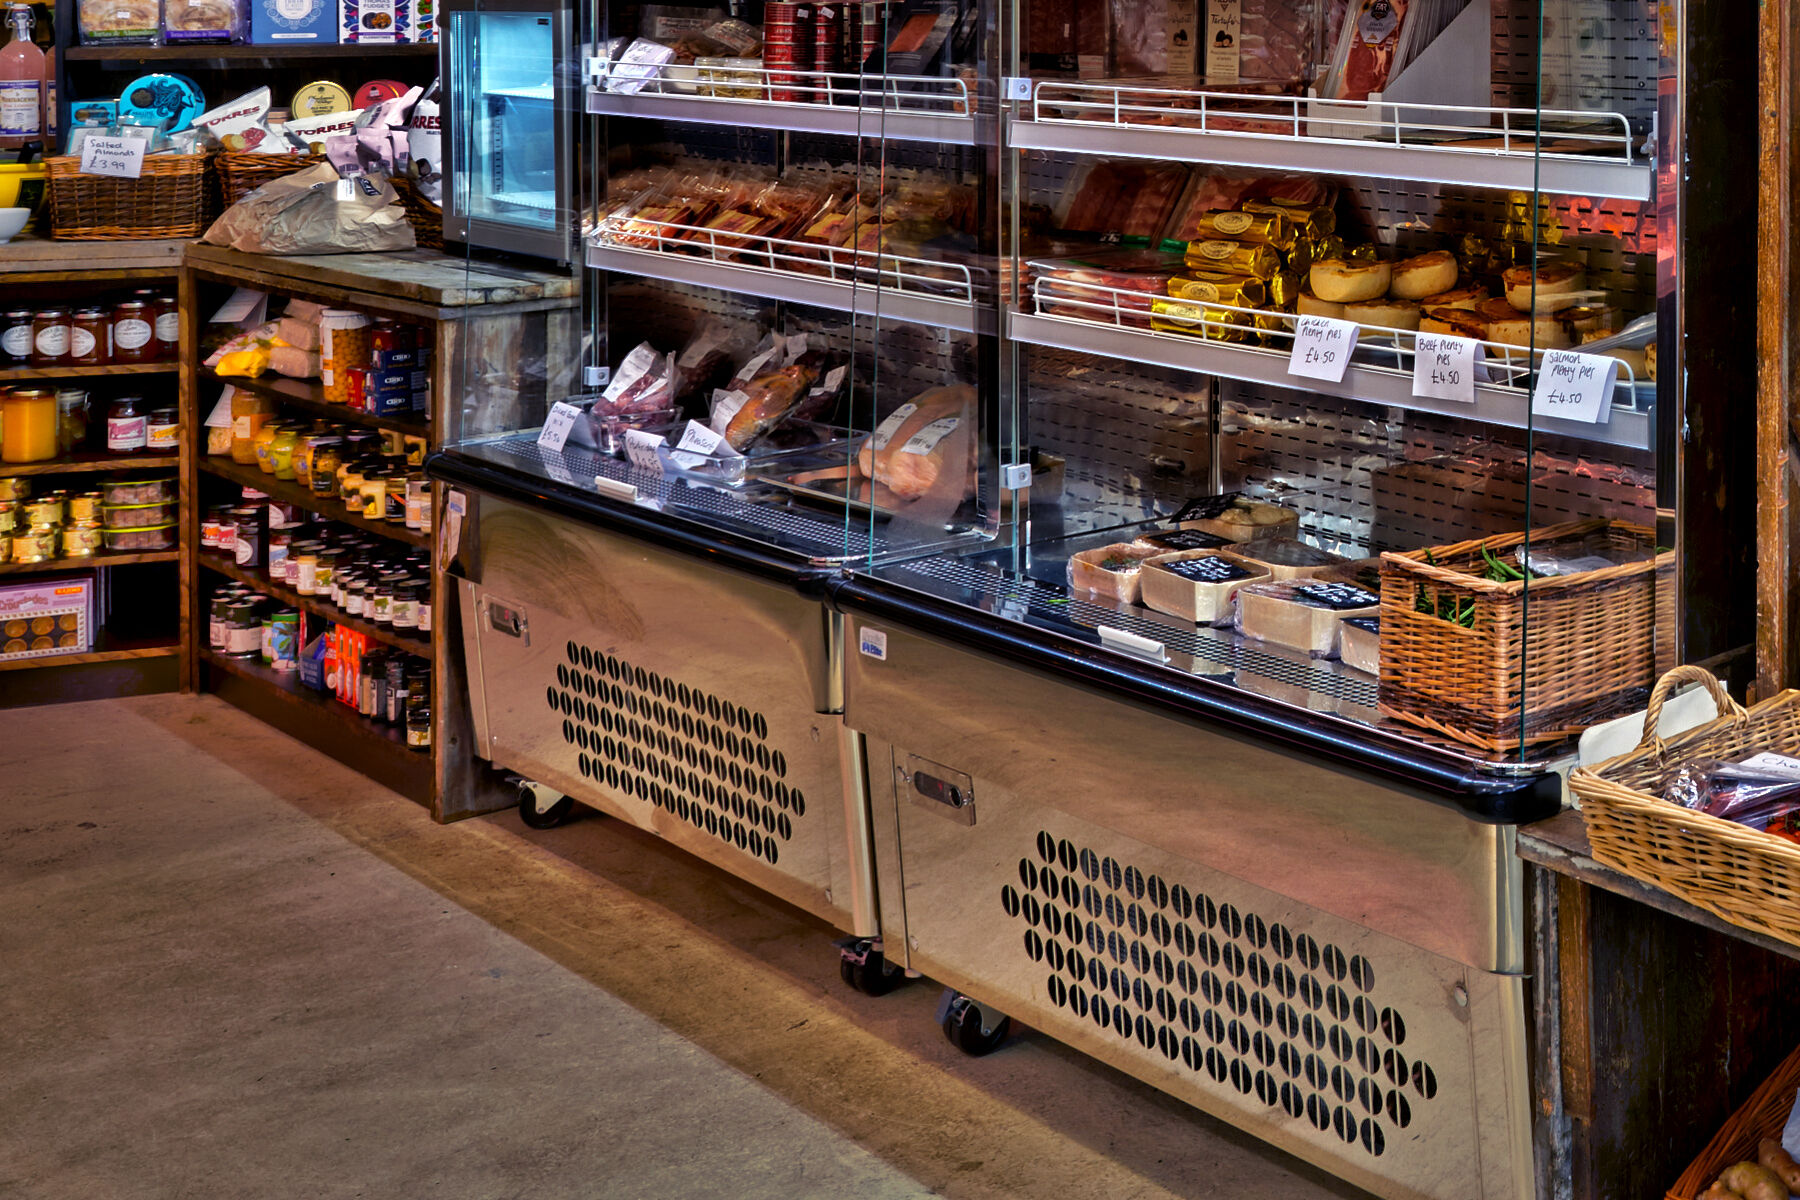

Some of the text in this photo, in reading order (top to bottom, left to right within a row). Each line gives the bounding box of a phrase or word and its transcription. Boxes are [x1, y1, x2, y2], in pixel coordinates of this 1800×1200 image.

[202, 106, 260, 128] TORRES
[295, 121, 355, 136] TORRES
[90, 140, 122, 148] Salted
[95, 148, 134, 157] Almonds
[90, 158, 125, 170] £3.99
[1419, 339, 1437, 351] Beef
[1305, 350, 1335, 364] £4.50
[1431, 371, 1459, 385] £4.50
[1548, 389, 1582, 403] £4.50
